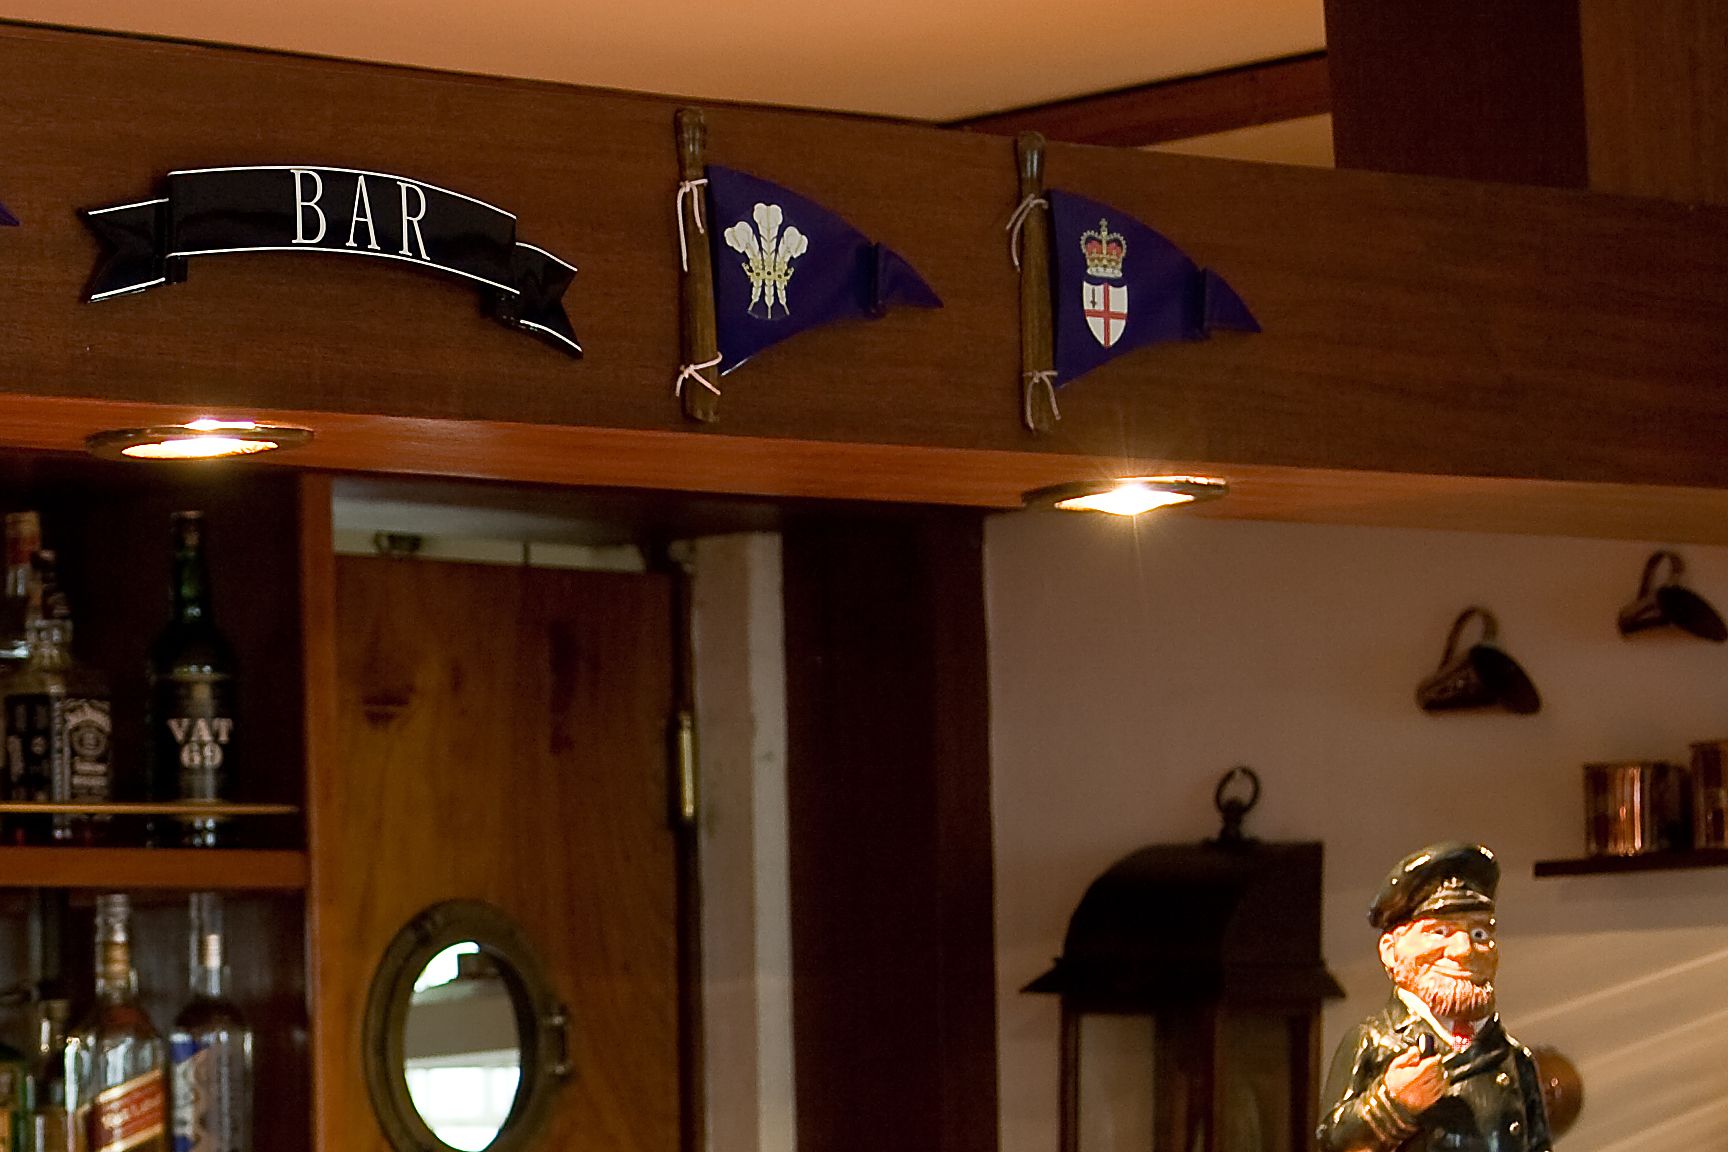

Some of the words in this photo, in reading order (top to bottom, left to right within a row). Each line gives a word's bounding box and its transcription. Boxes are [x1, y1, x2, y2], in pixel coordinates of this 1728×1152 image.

[290, 169, 430, 260] BAR
[166, 717, 233, 744] VAT
[180, 743, 223, 769] 69
